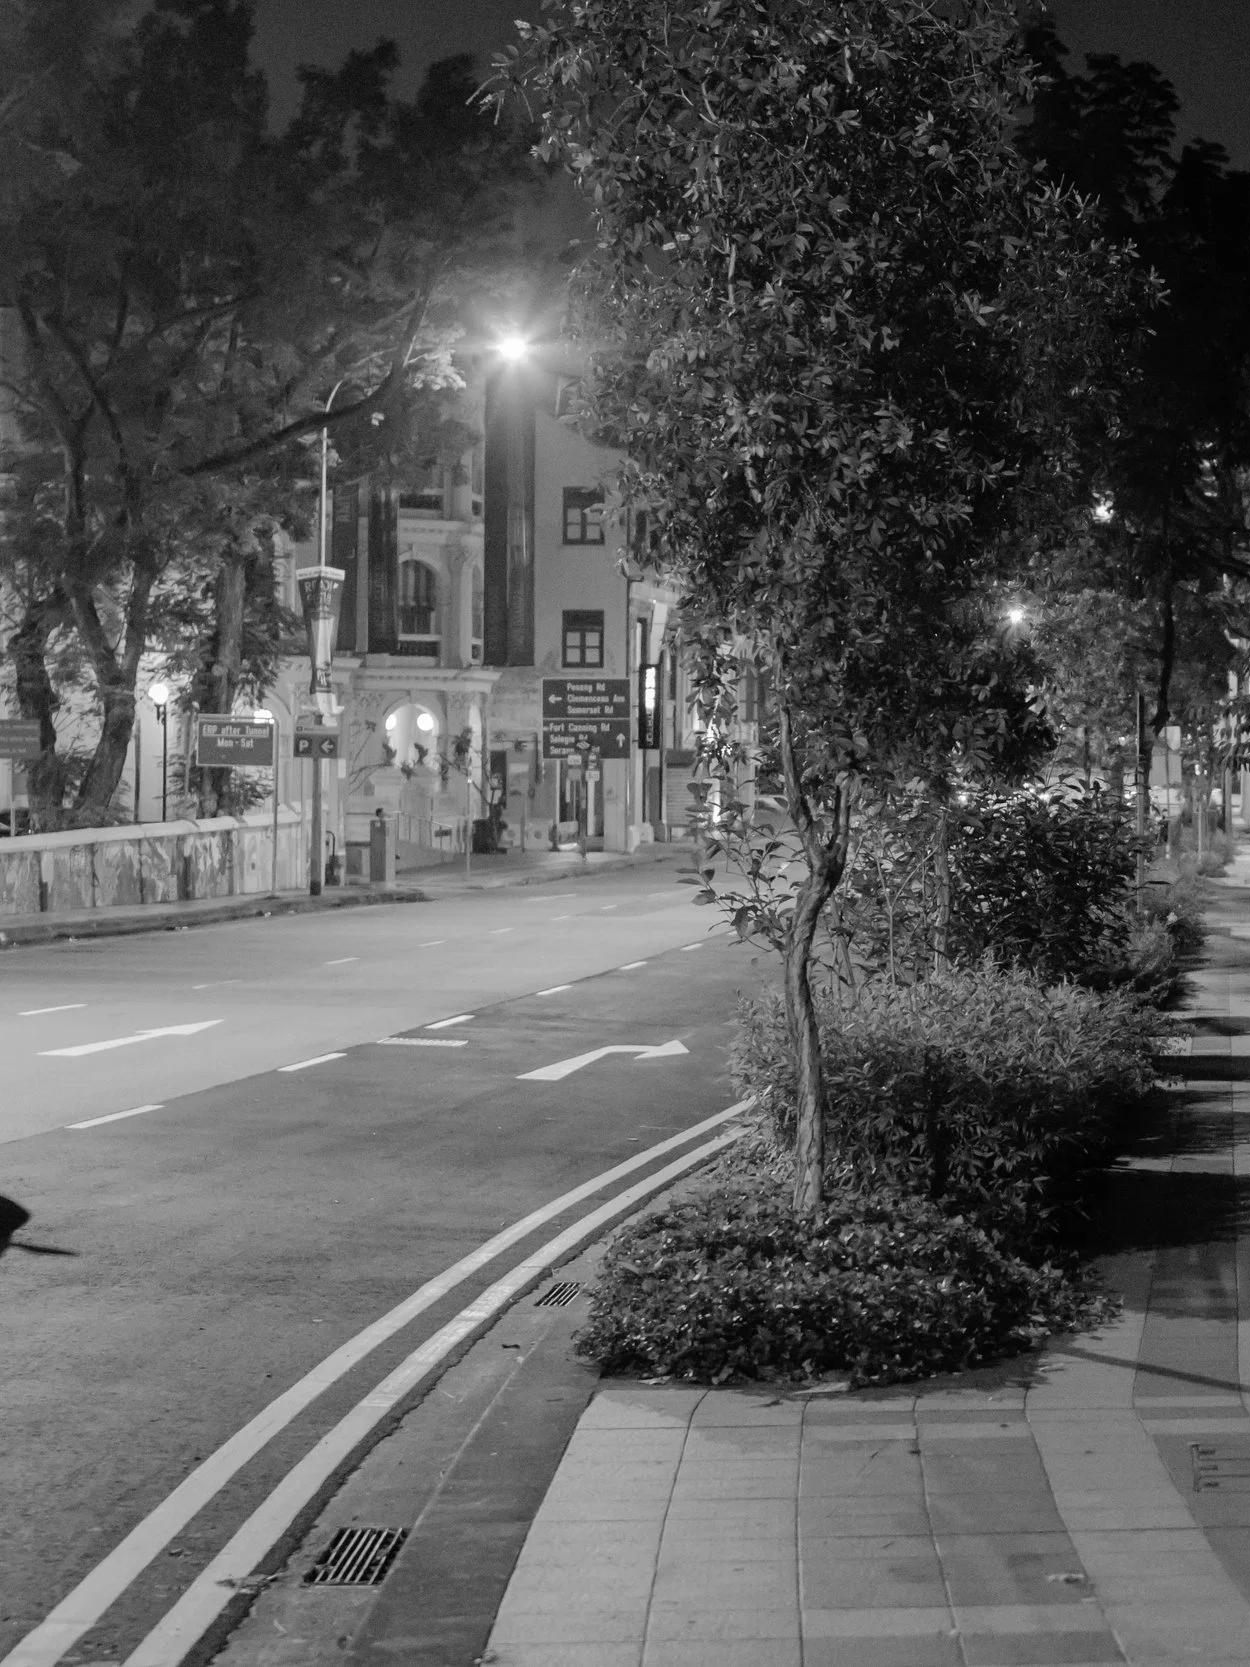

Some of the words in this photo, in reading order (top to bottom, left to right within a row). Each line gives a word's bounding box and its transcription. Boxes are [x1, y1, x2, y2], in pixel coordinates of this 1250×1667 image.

[596, 683, 606, 691] Rd
[613, 694, 625, 703] Ave
[567, 705, 600, 714] Somerset
[604, 705, 613, 714] Rd
[203, 724, 218, 736] ERP
[221, 724, 241, 736] after
[245, 725, 270, 737] Tunnel
[549, 723, 564, 732] Fort
[568, 723, 598, 733] Canning
[600, 723, 610, 732] Rd
[217, 738, 234, 748] Mon
[240, 738, 254, 749] Sat
[299, 739, 309, 752] P
